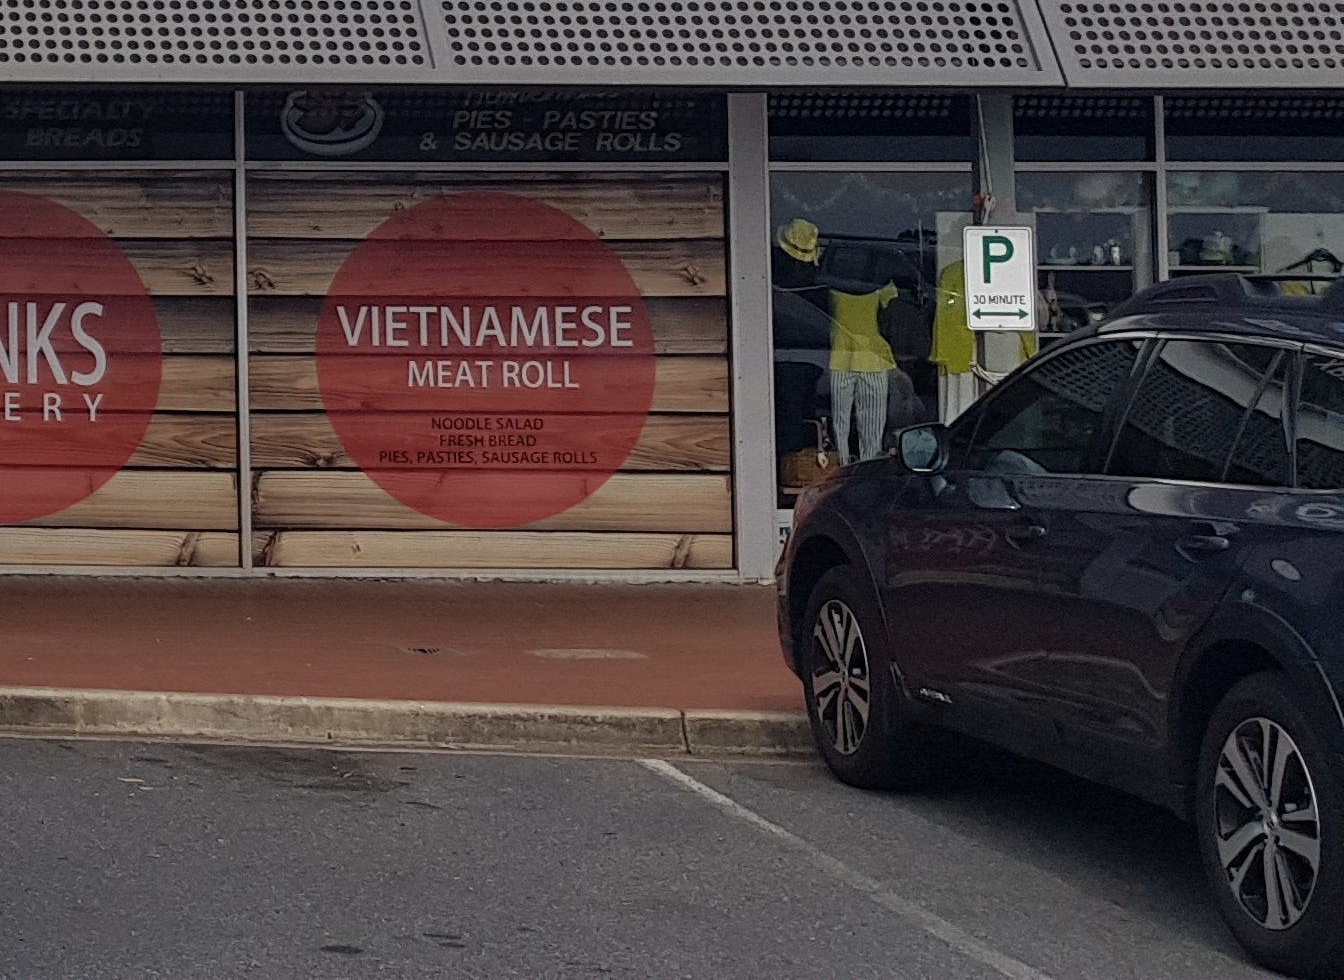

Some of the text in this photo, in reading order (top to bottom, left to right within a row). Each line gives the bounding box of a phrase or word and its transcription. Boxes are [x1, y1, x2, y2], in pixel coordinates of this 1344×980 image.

[4, 100, 156, 119] SPECIALTY
[452, 110, 513, 129] PIES
[543, 110, 659, 130] PASTIES
[25, 127, 144, 147] BREADS
[419, 132, 683, 151] & SAUSAGE ROLLS
[983, 236, 1014, 283] P
[973, 295, 1026, 305] 30 MINUTE
[336, 305, 633, 347] VIETNAMESE
[408, 360, 579, 388] MEAT ROLL
[431, 418, 544, 430] NOODLE SALAD
[439, 435, 537, 447] FRESH BREAD
[379, 451, 413, 465] PIES,
[482, 451, 549, 464] SAUSAGE
[553, 451, 597, 464] ROLLS
